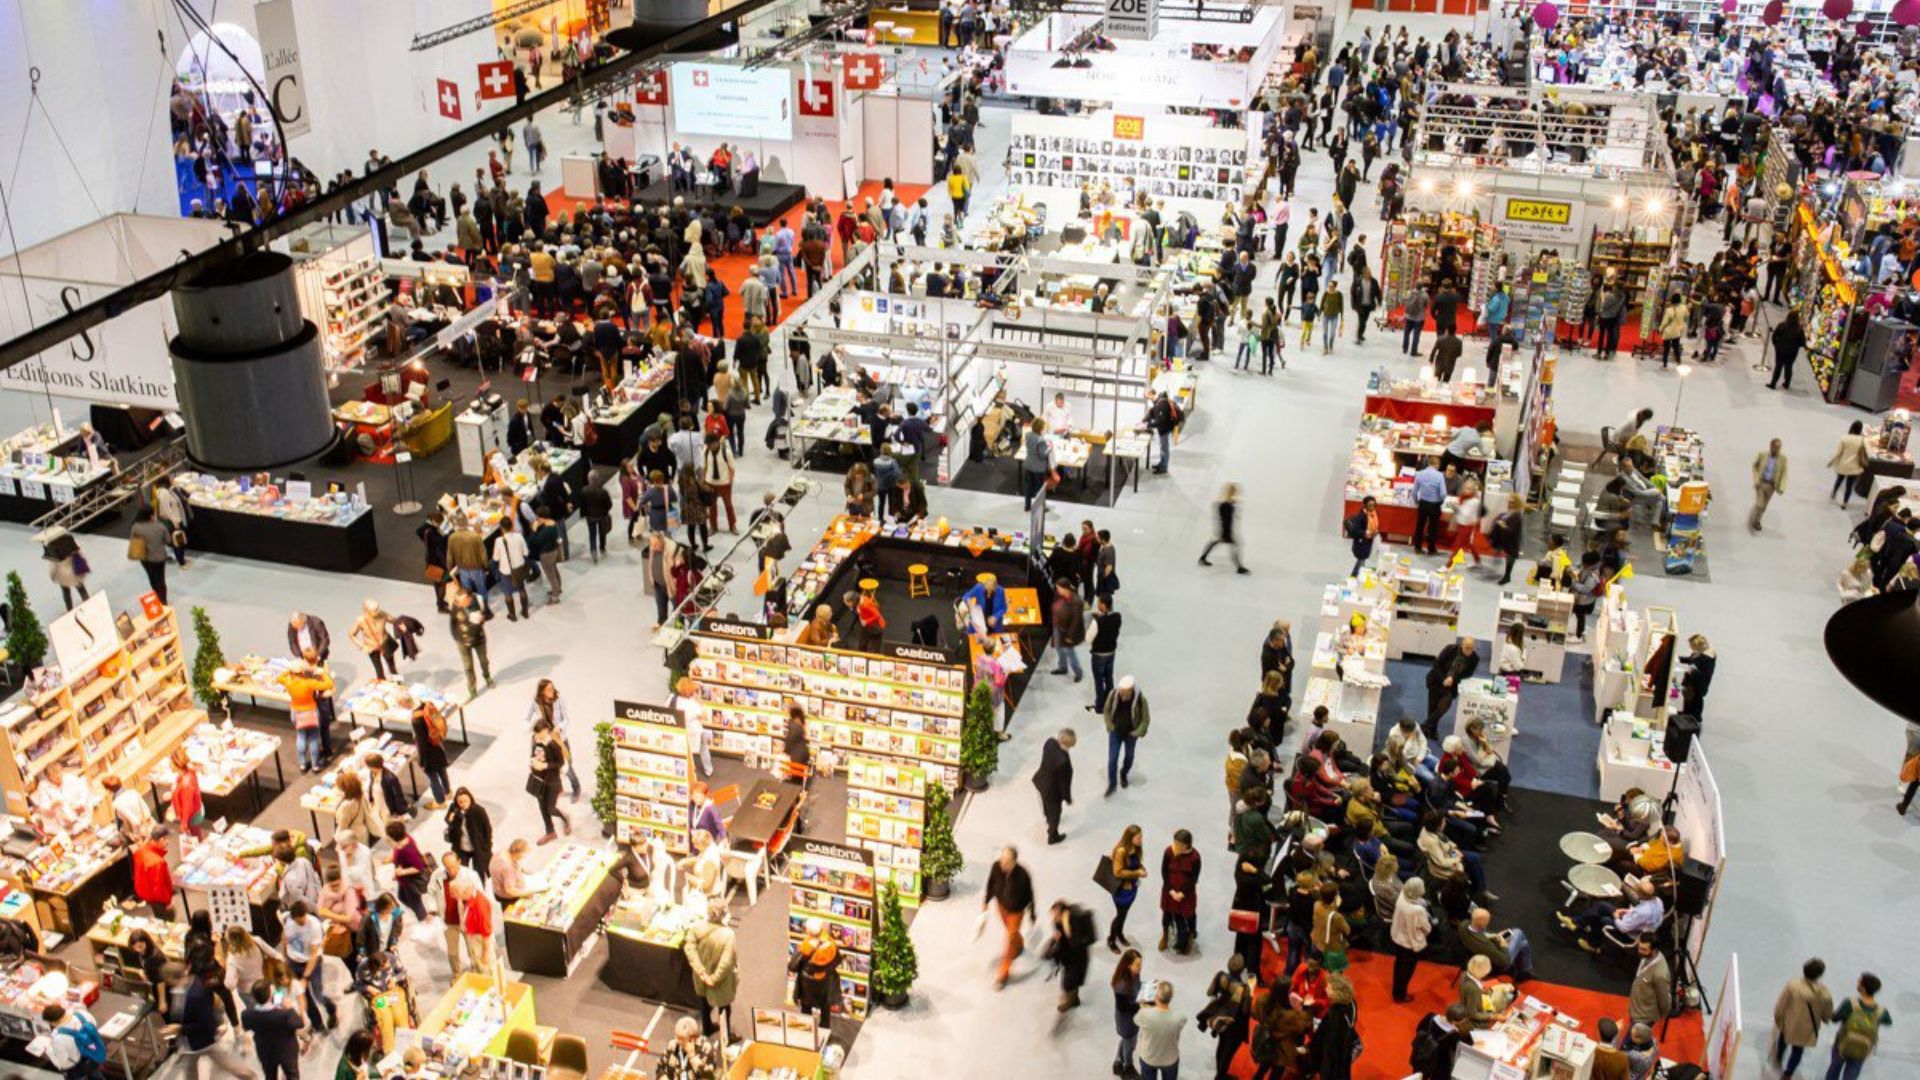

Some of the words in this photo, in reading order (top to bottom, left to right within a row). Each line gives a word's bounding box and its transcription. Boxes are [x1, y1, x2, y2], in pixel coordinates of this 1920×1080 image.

[1108, 21, 1147, 33] éditions
[273, 73, 302, 123] C
[7, 362, 84, 388] Editions
[88, 369, 169, 398] Slatkine
[626, 708, 677, 725] CABÉDITA
[805, 842, 863, 862] CABÉDITA
